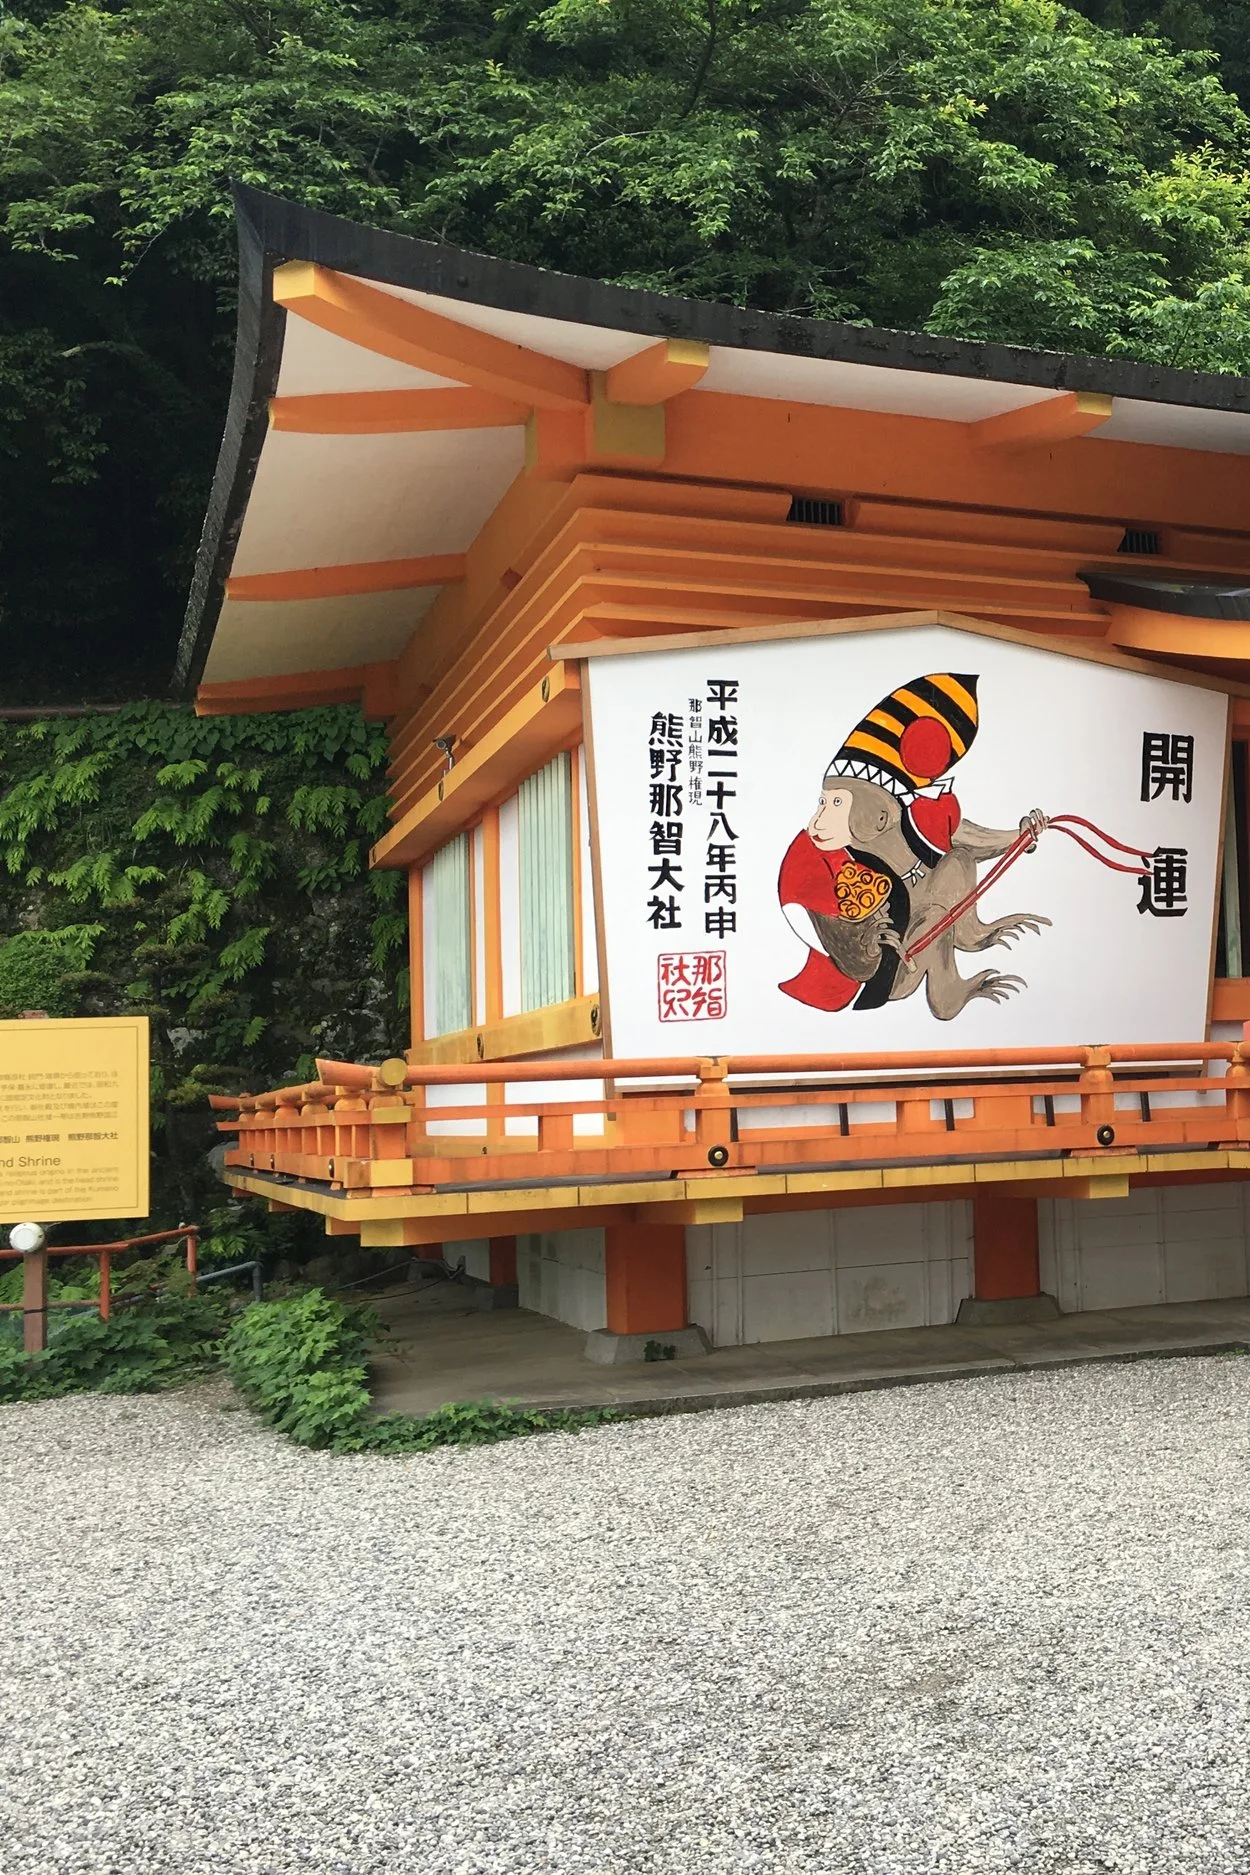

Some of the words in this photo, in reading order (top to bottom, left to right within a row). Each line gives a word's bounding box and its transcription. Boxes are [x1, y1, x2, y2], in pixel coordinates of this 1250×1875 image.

[646, 711, 685, 929] 熊野那智大社
[688, 698, 703, 806] 那智山熊野権現
[705, 679, 740, 939] 平成二十八年丙申
[1136, 731, 1195, 917] 開運
[18, 1155, 61, 1168] Shrine
